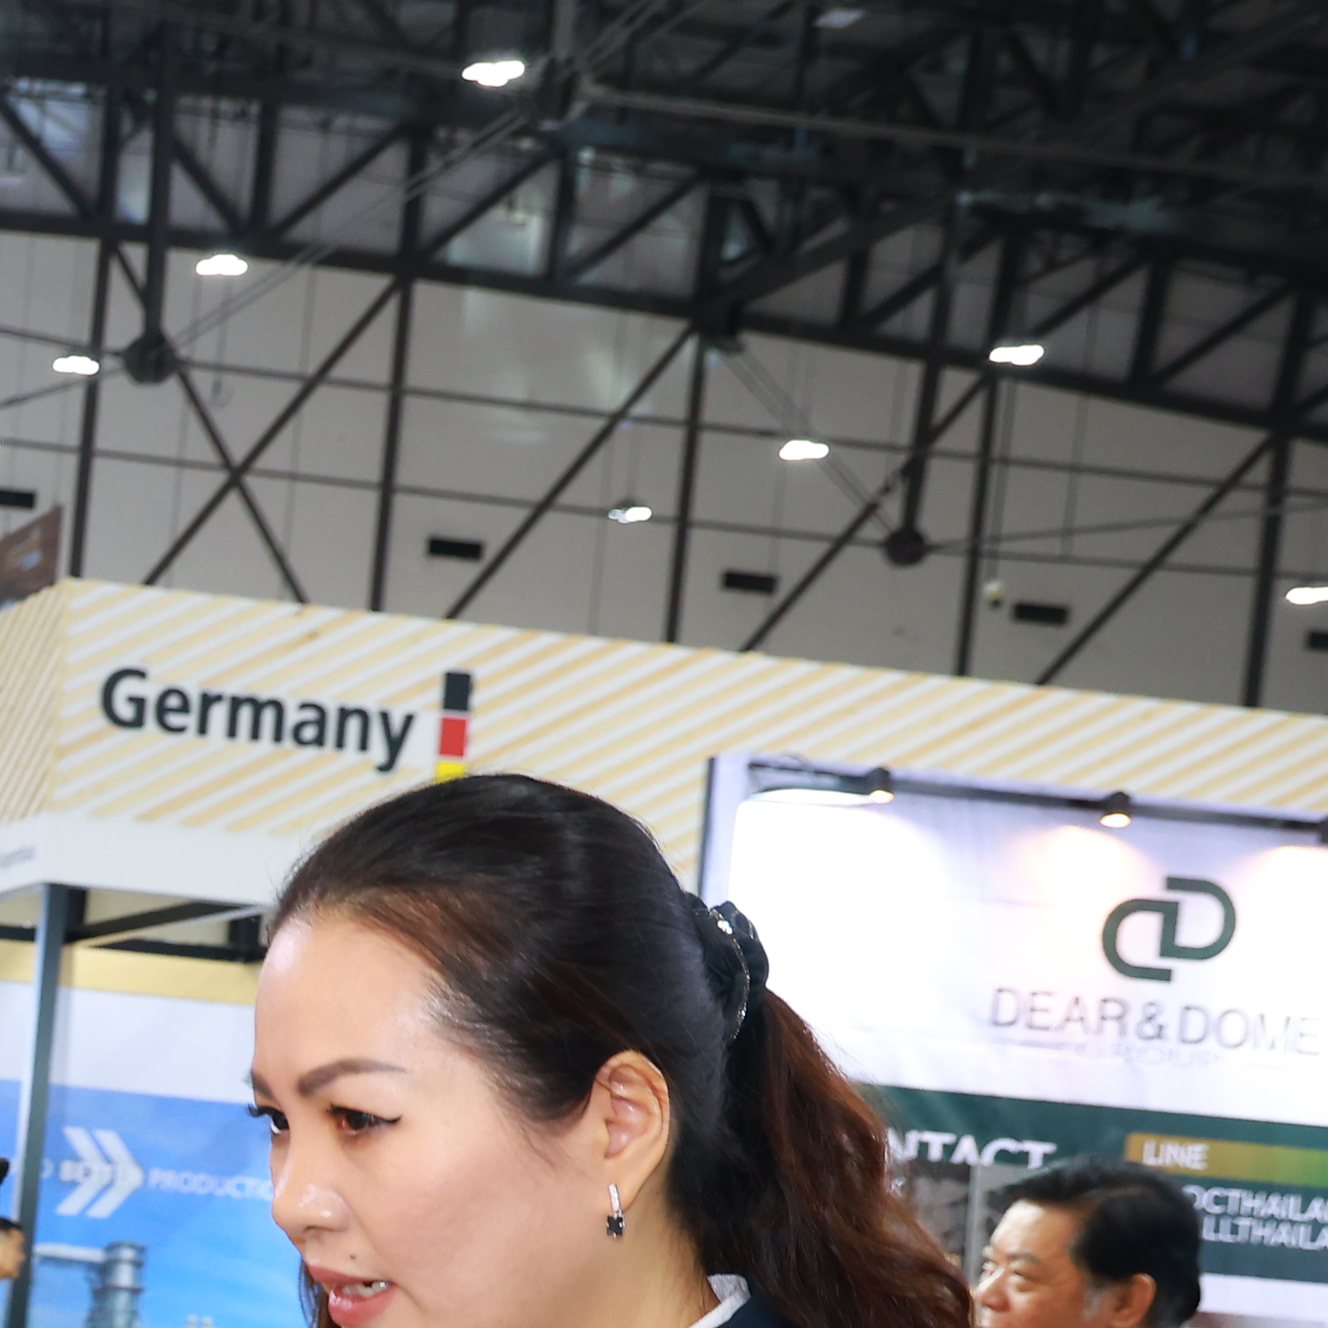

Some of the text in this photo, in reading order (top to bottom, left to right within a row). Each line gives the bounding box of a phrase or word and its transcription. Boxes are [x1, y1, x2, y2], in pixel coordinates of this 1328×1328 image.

[101, 667, 415, 773] Germany
[887, 1128, 1057, 1170] NTACT
[1143, 1140, 1210, 1171] LINE
